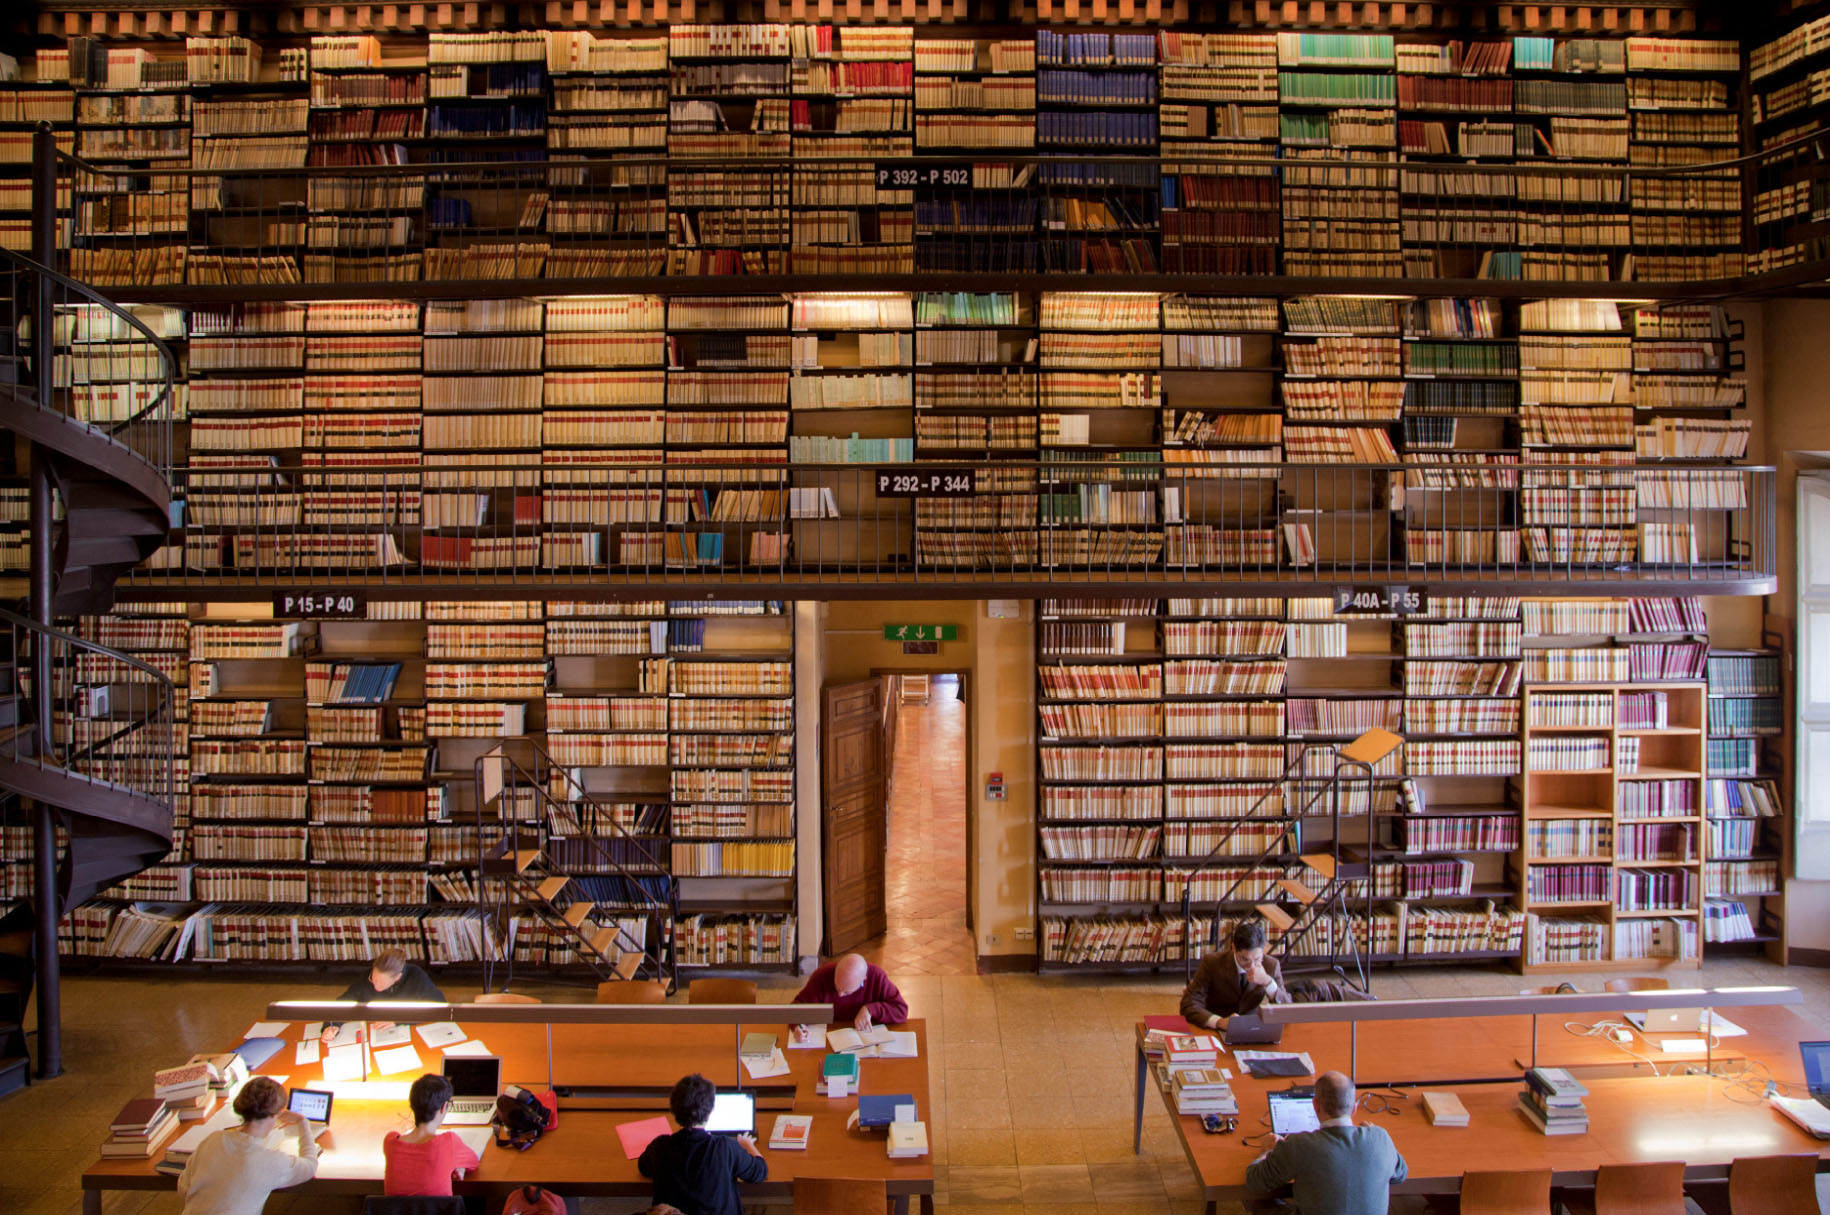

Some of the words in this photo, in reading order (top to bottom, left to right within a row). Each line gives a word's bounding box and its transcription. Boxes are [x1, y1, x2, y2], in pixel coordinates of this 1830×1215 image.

[880, 170, 888, 184] P
[893, 170, 917, 184] 392
[930, 170, 939, 184] P
[943, 170, 968, 184] 502
[880, 476, 889, 491] P
[893, 476, 918, 491] 292
[931, 476, 940, 491] P
[944, 476, 969, 491] 344
[285, 597, 293, 612] P
[298, 597, 313, 612] 15
[325, 597, 334, 612] P
[337, 597, 354, 612] 40
[1341, 593, 1349, 608] P
[1353, 593, 1379, 608] 40A
[1391, 593, 1400, 608] P
[1403, 593, 1420, 608] 55
